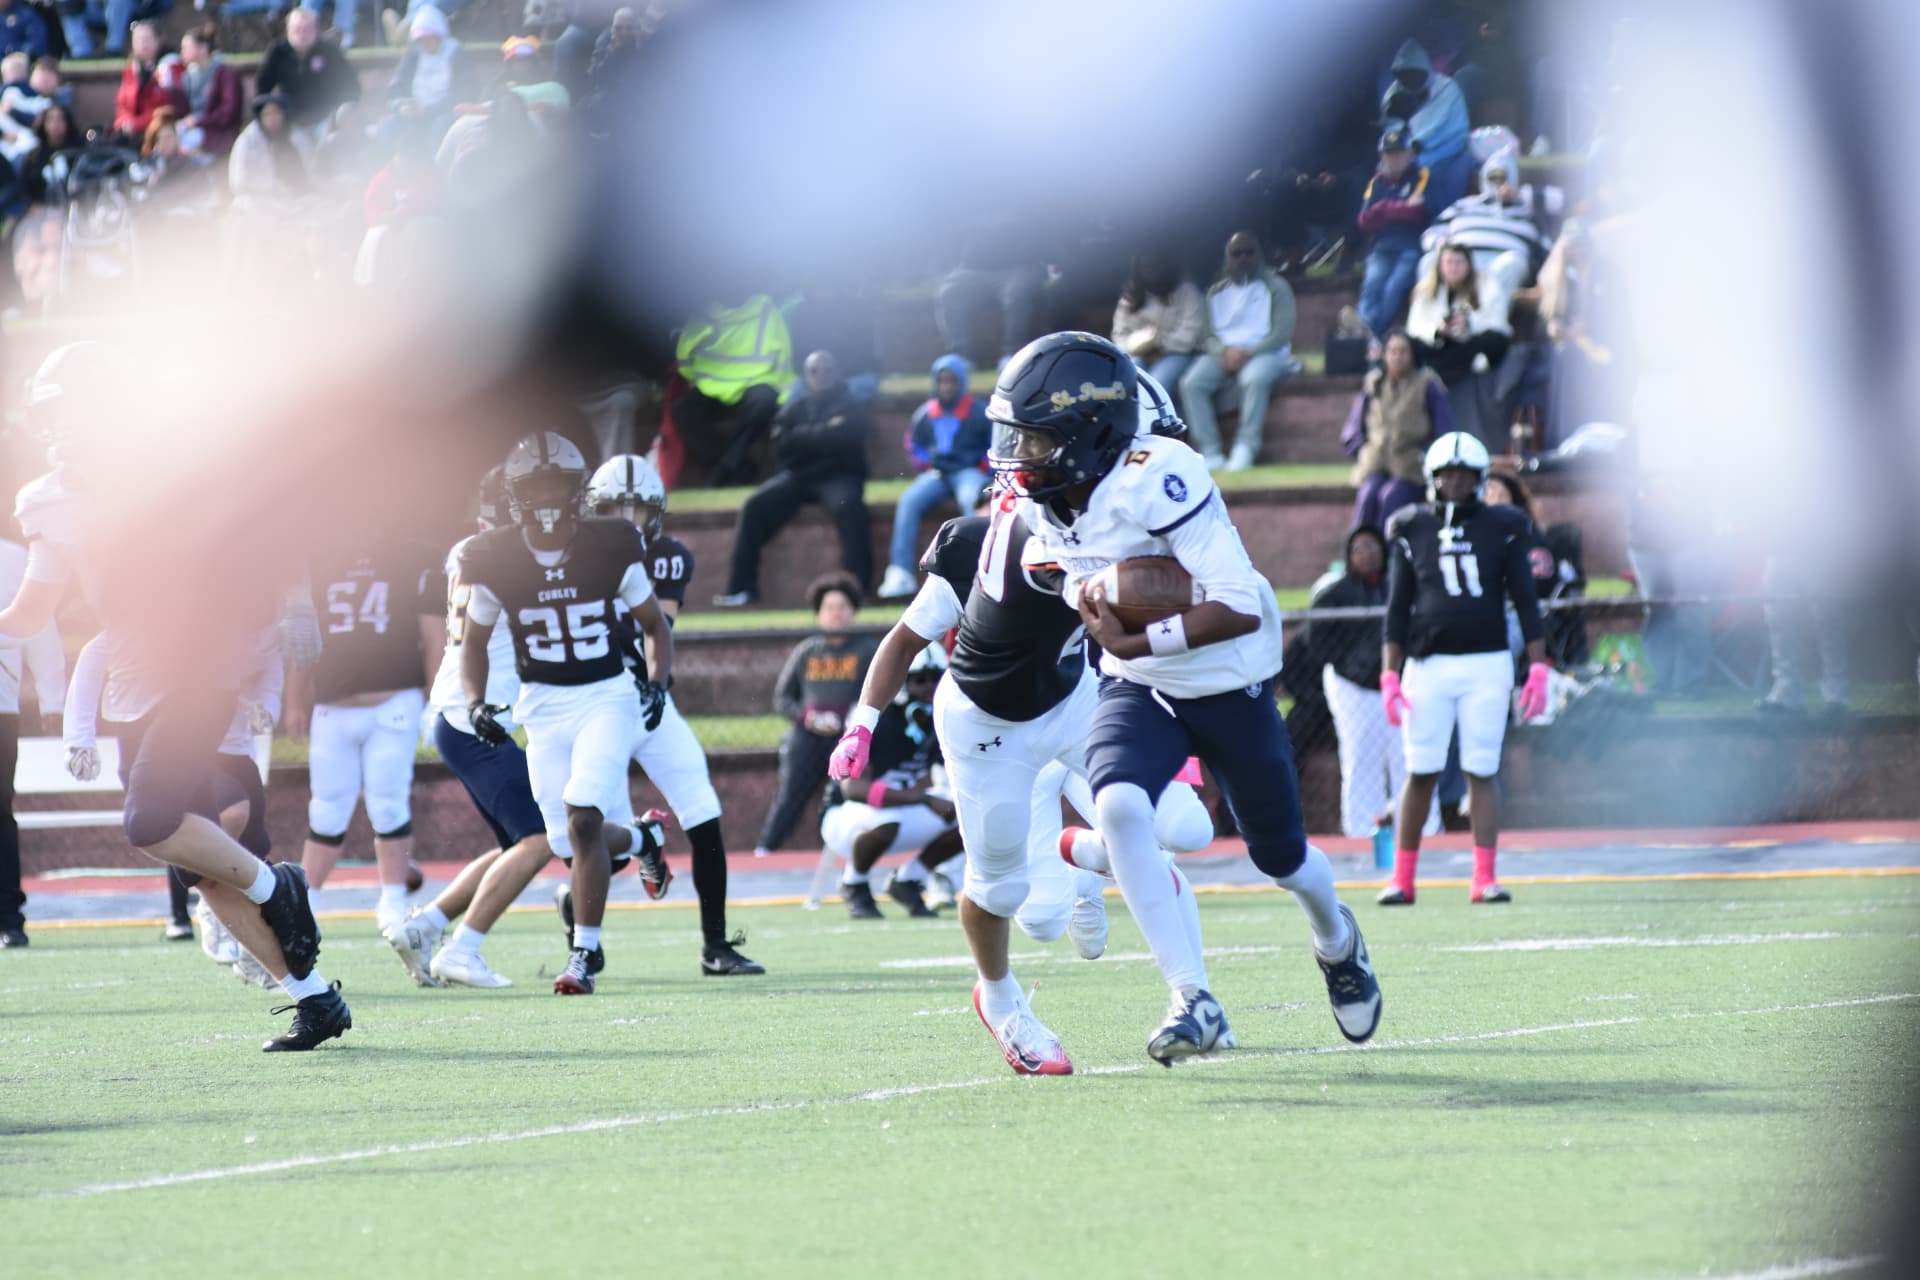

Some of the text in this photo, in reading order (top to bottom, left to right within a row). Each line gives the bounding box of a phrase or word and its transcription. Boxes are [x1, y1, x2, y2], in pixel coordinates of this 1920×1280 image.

[1438, 554, 1484, 597] 11
[327, 581, 391, 635] 54
[518, 598, 611, 663] 25
